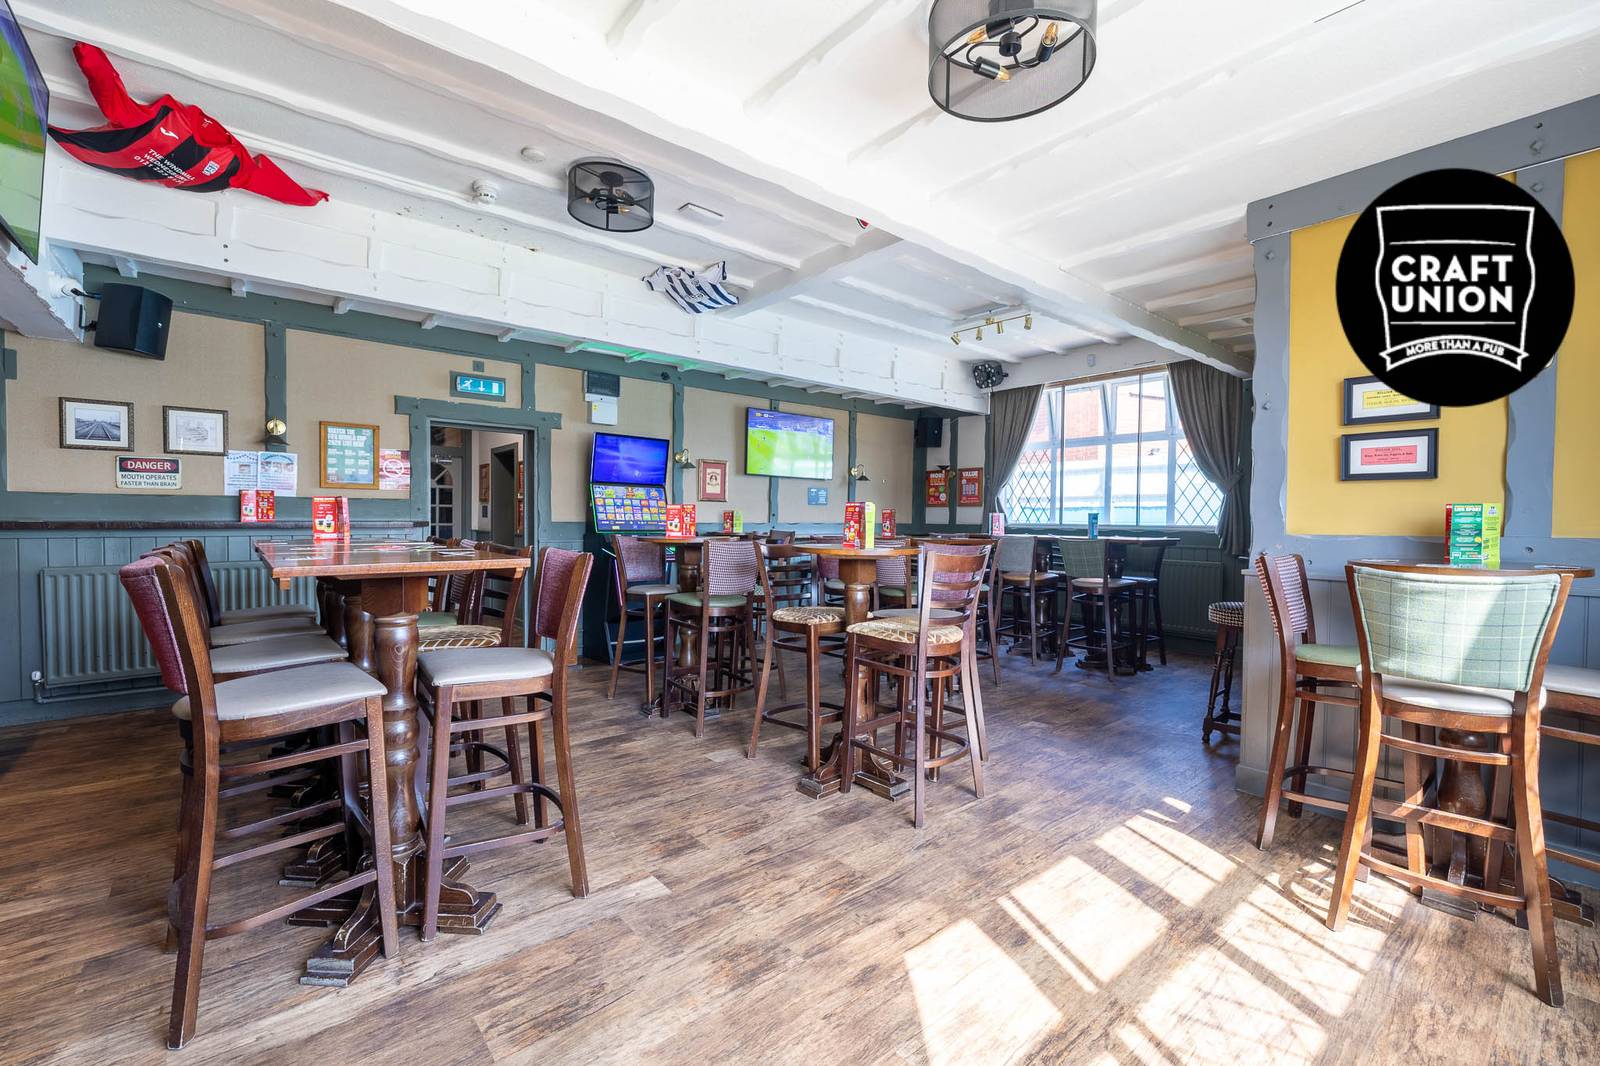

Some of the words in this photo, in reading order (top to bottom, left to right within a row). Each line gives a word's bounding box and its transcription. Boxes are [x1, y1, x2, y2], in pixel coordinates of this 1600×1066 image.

[148, 148, 165, 160] THE
[164, 159, 196, 180] WINDMILL
[127, 461, 171, 470] DANGER
